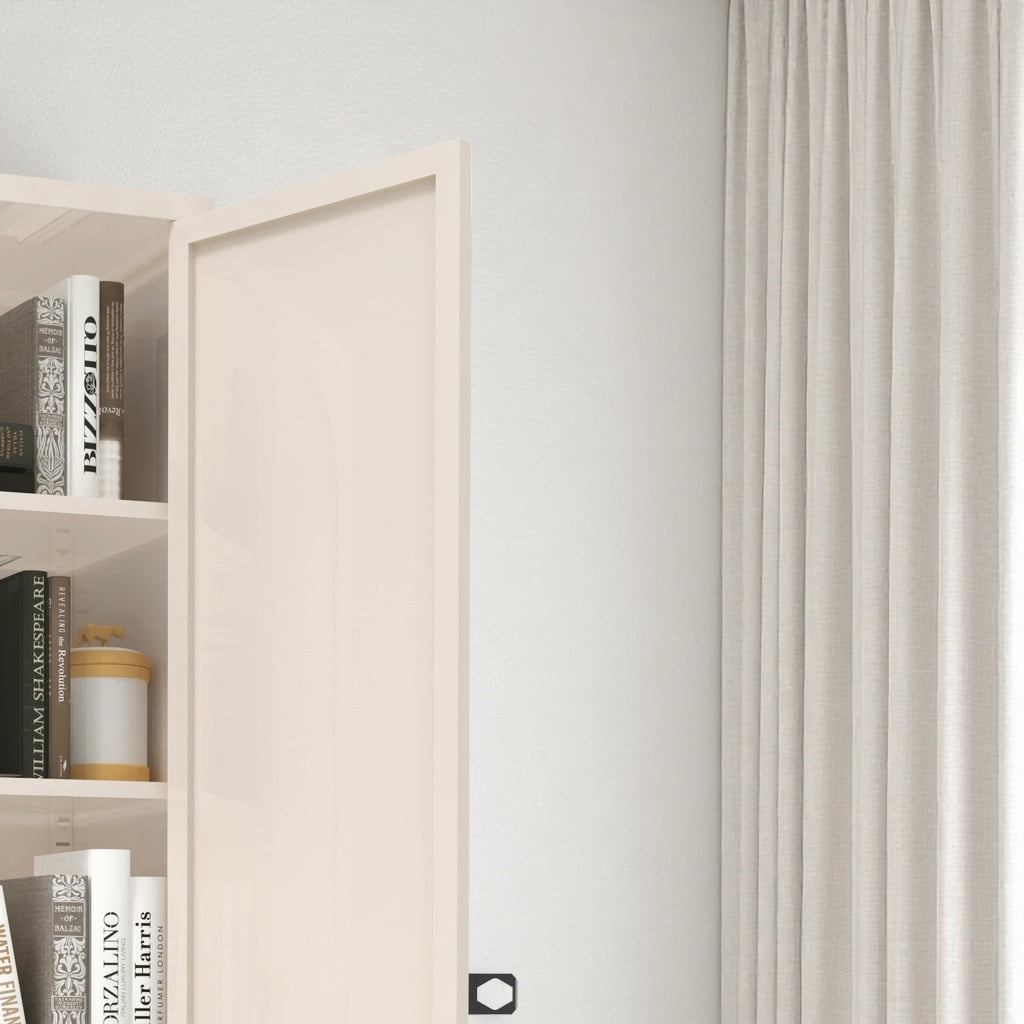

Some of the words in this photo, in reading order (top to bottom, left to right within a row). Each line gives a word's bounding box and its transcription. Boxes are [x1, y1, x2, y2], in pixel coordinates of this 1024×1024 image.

[39, 328, 63, 336] MEMOIR
[58, 586, 66, 633] REVEALING
[33, 575, 45, 702] SHAKESPEARE
[58, 649, 67, 703] Revolution
[54, 905, 83, 913] MEMOIR
[134, 912, 151, 978] Harris
